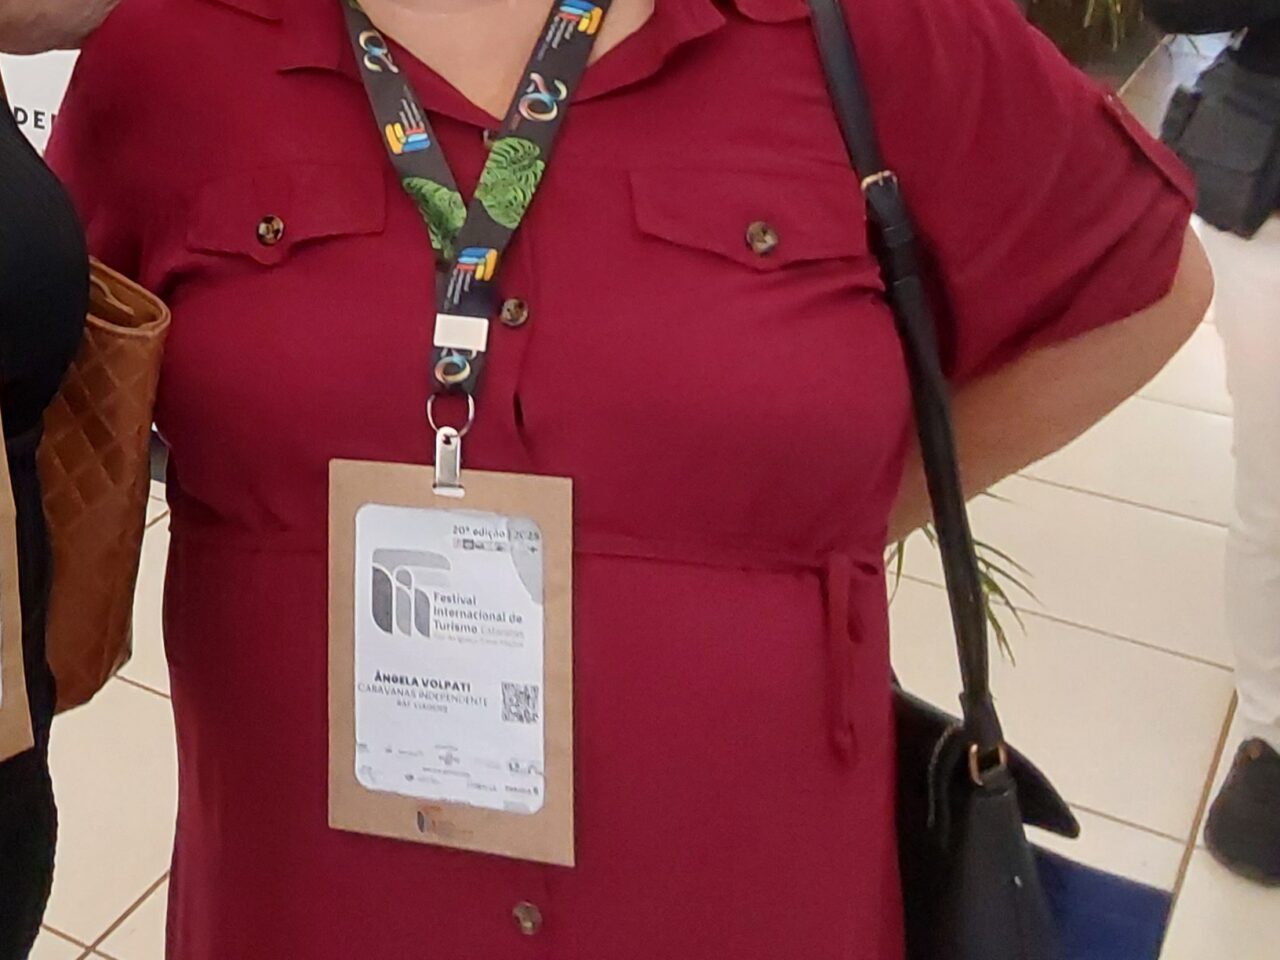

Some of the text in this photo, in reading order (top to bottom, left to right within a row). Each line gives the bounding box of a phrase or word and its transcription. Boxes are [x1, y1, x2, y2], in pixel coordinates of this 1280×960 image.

[433, 592, 477, 607] Festival
[433, 606, 523, 625] Internacional de
[433, 619, 478, 635] Turismo
[374, 669, 471, 692] ÂNGELA VOLPATI
[357, 683, 488, 708] CARAVANAS INDEPENDENTE
